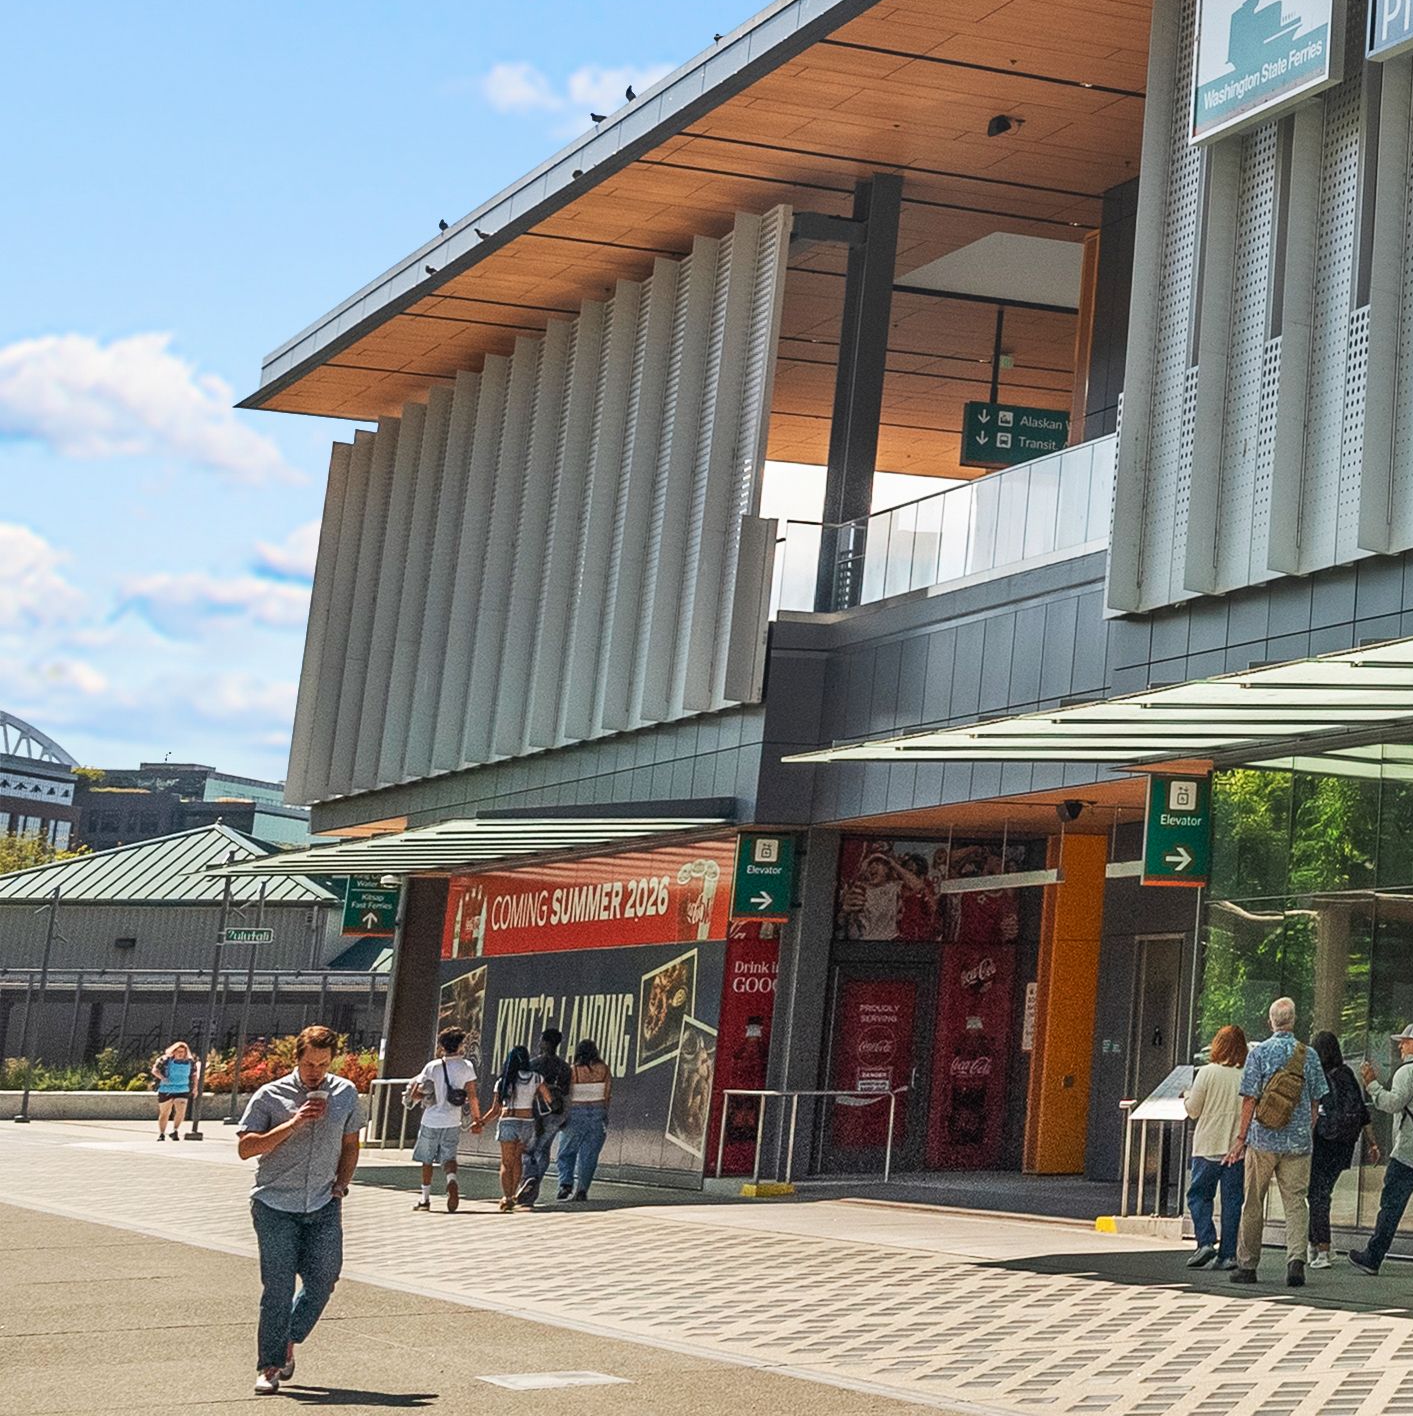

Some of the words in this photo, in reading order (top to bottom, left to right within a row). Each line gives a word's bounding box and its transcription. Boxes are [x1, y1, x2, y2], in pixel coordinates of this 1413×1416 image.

[1204, 71, 1261, 110] Washington
[1261, 58, 1288, 83] State
[1288, 39, 1323, 71] Ferries
[1020, 415, 1063, 430] Alaskan
[1160, 813, 1203, 826] Elevator
[746, 864, 783, 875] Elevator
[352, 901, 367, 909] Fast
[491, 890, 549, 931] COMING
[550, 882, 623, 926] SUMMER
[624, 875, 671, 919] 2026
[734, 960, 769, 974] Drink
[860, 1004, 900, 1013] PROUDLY
[860, 1014, 898, 1023] SERVING
